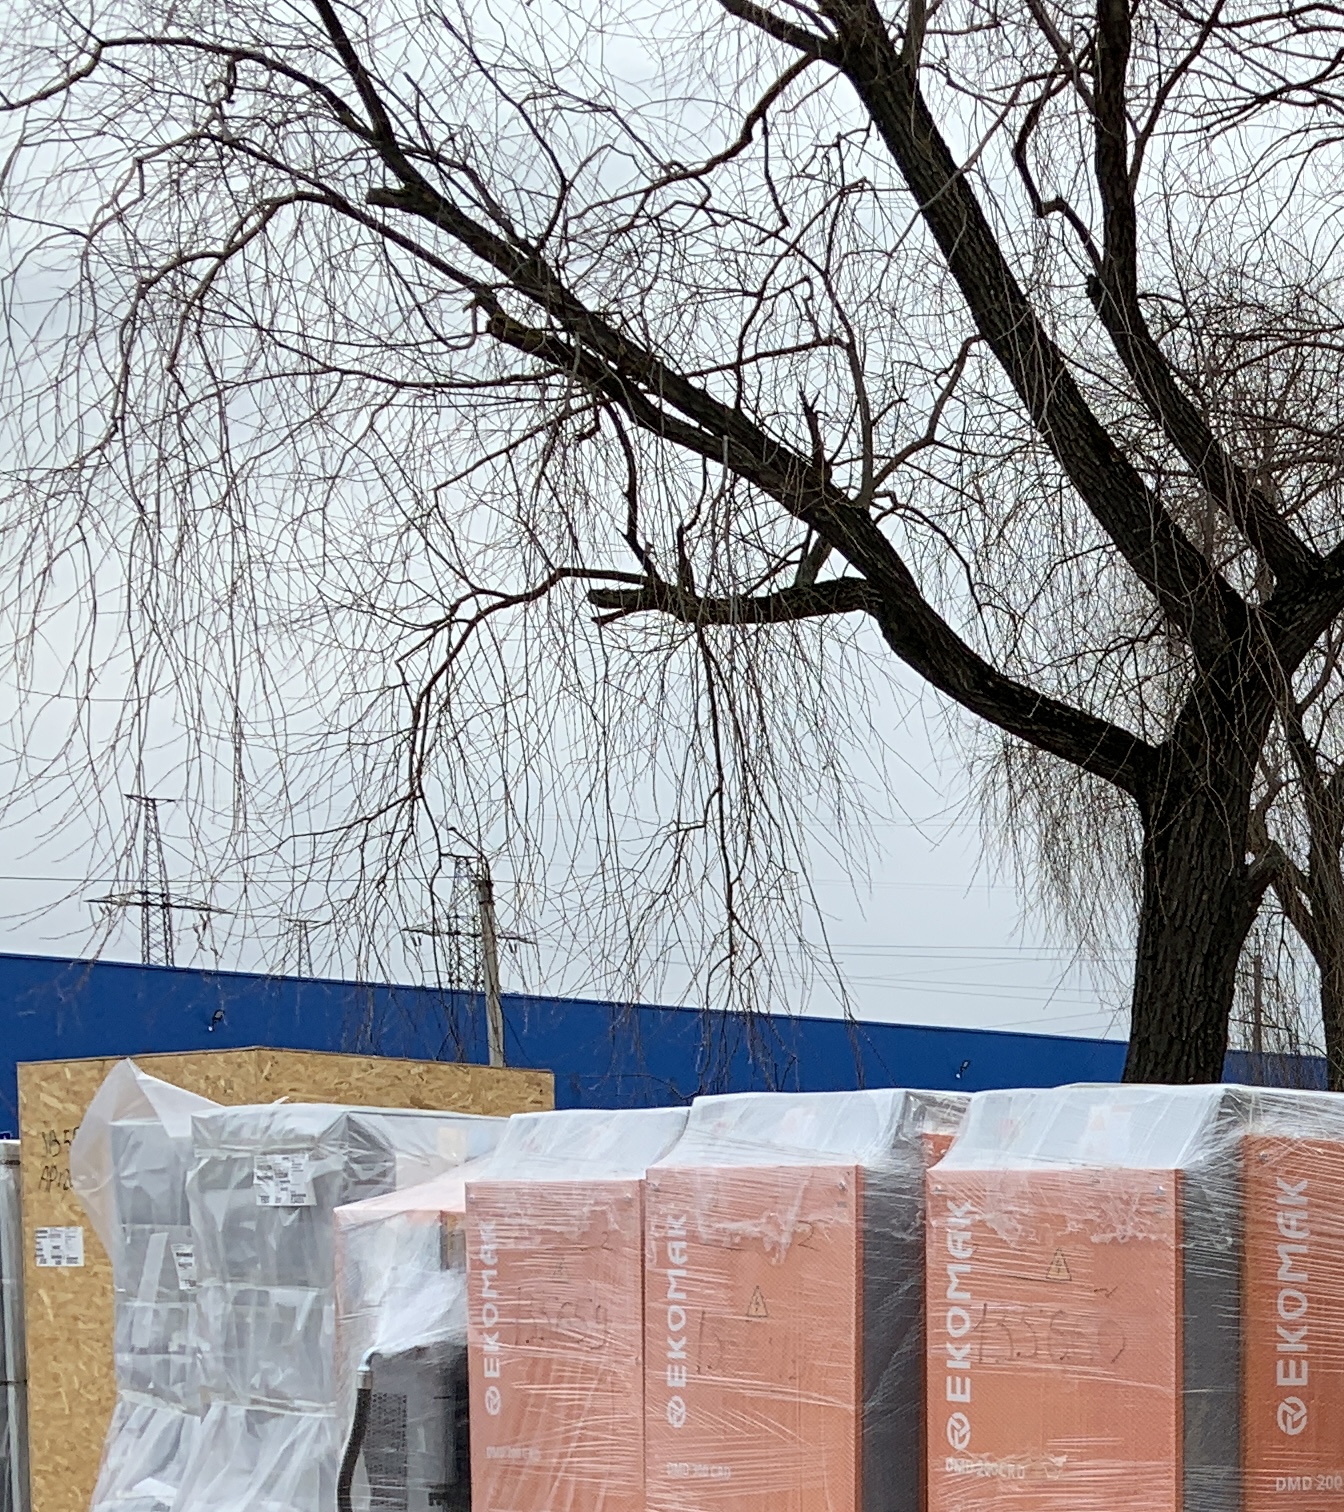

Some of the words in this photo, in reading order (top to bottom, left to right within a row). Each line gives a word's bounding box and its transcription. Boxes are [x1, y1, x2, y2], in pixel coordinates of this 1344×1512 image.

[480, 1221, 499, 1377] EKOMAK
[667, 1214, 688, 1387] EKOMAK
[946, 1199, 972, 1403] EKOMAK
[1277, 1177, 1310, 1386] EKOMAK
[1276, 1476, 1313, 1491] DMD
[1316, 1475, 1342, 1490] 200
